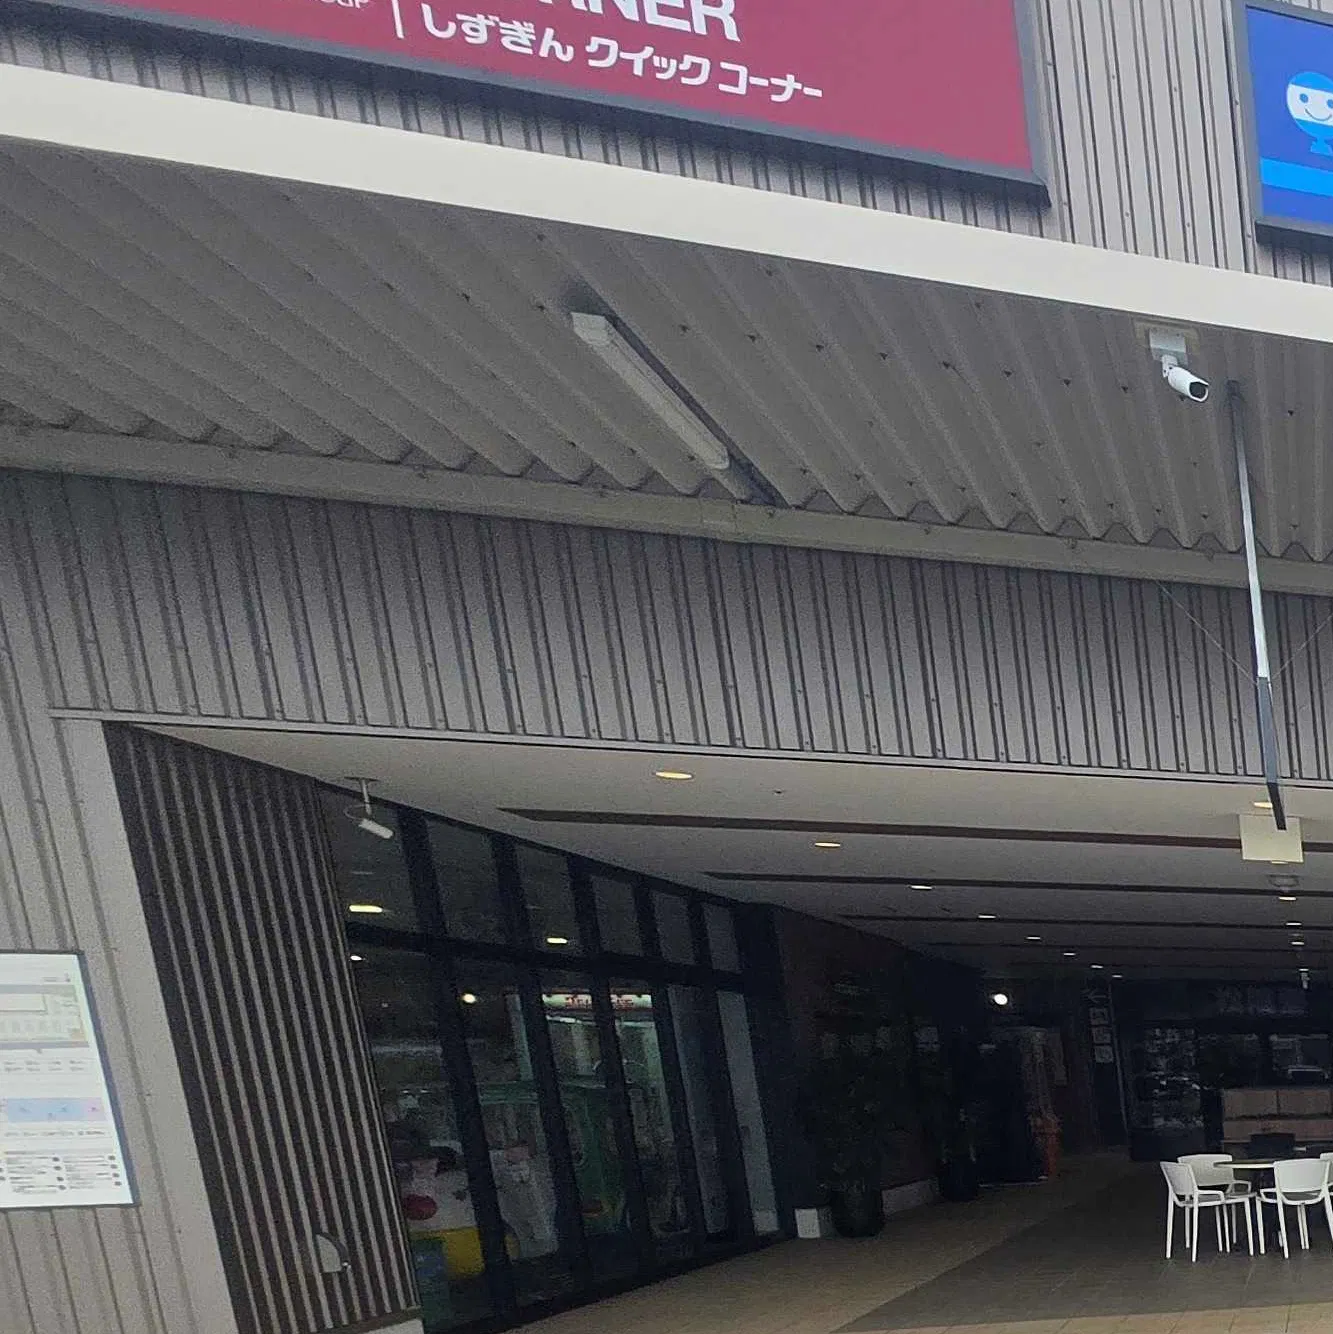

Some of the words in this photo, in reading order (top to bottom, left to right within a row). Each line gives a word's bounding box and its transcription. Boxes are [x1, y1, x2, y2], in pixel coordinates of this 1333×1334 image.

[423, 2, 574, 62] しずぎん
[586, 37, 710, 84] クイック
[718, 61, 823, 102] コーナー
